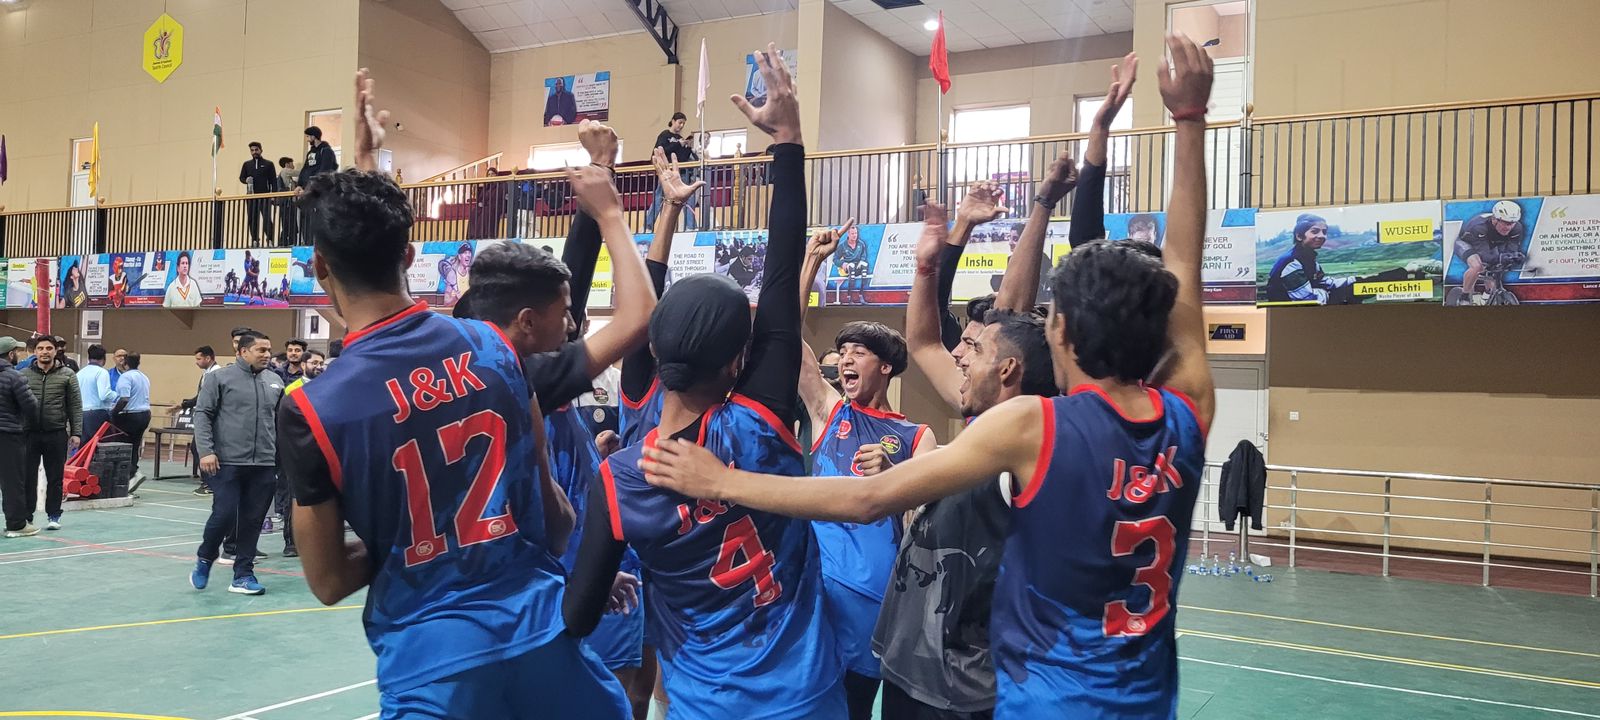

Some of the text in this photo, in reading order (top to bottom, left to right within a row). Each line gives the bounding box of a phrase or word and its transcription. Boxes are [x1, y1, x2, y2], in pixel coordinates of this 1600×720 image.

[966, 256, 993, 267] Insha
[1385, 225, 1428, 236] WUSHU
[1361, 283, 1421, 294] Ansa Chishti
[386, 351, 487, 424] J&K
[392, 409, 519, 567] 12
[1106, 445, 1184, 503] J&K
[708, 514, 783, 608] 4
[1102, 515, 1177, 638] 3
